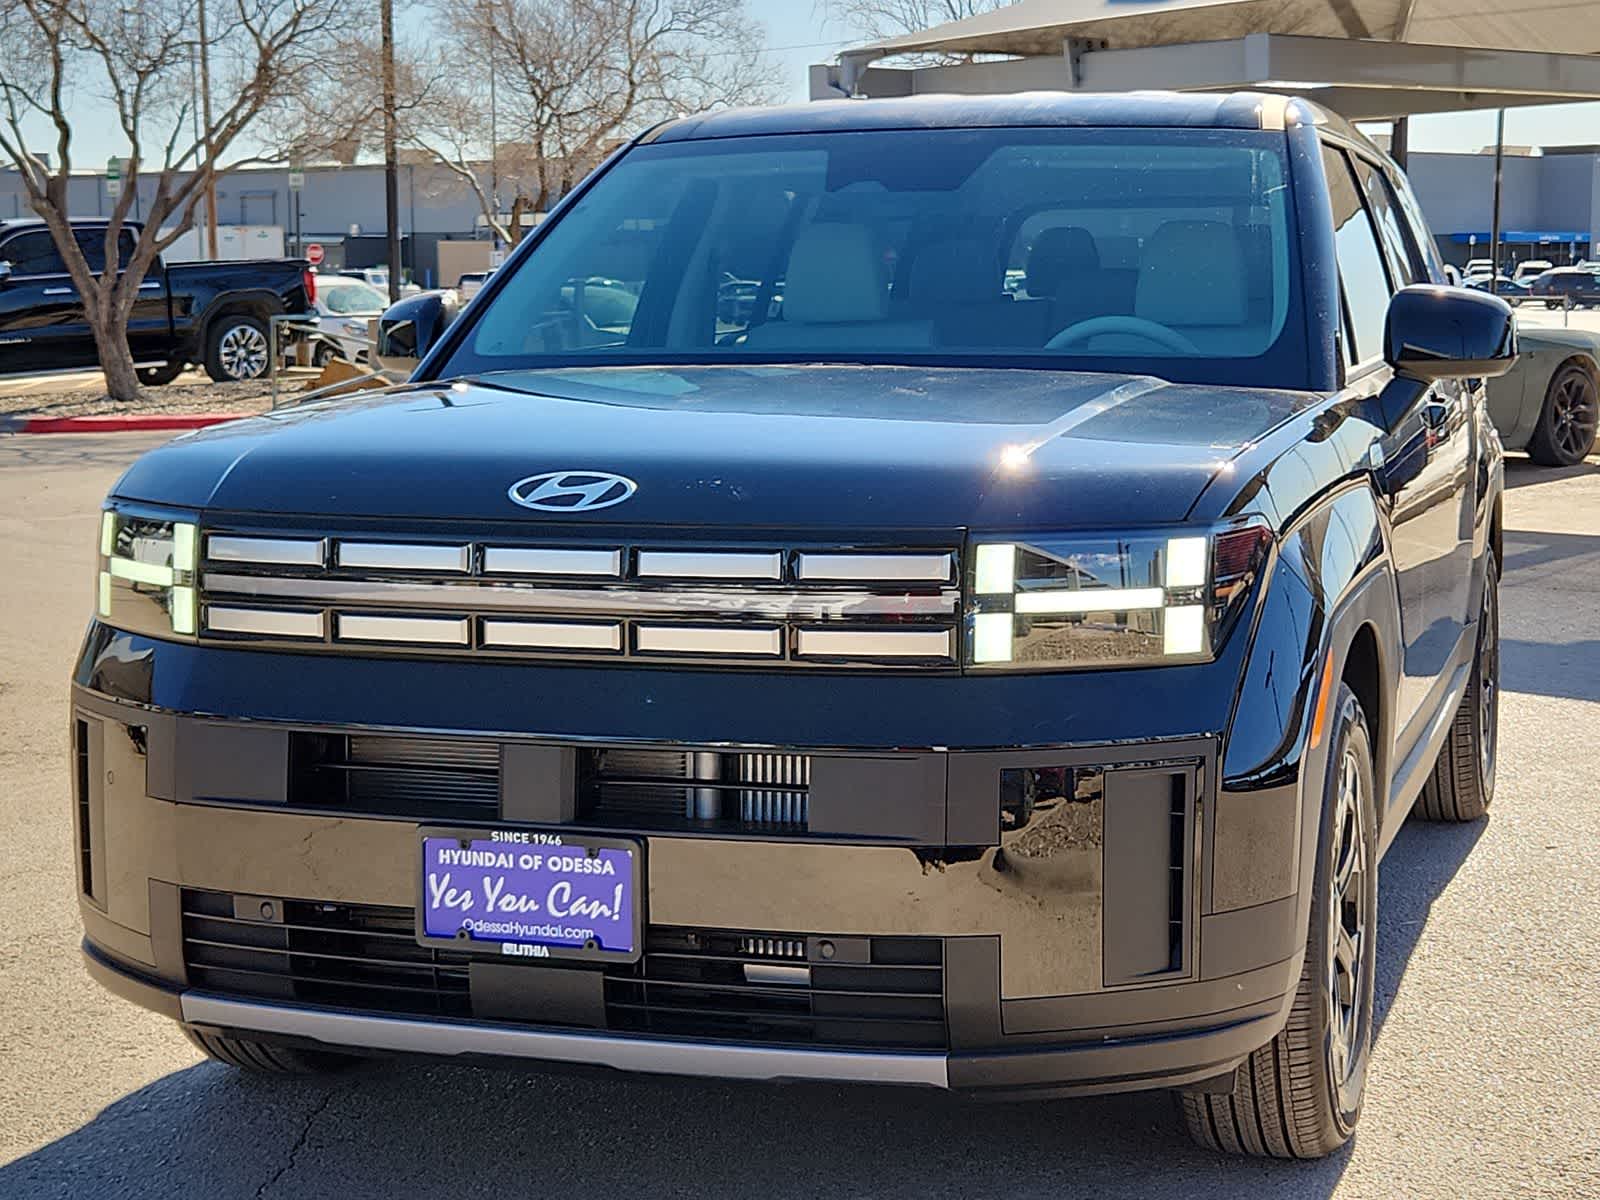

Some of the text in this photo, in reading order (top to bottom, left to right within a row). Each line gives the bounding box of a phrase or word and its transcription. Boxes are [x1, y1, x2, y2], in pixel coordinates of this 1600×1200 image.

[491, 831, 562, 846] SINCE 1946
[438, 849, 615, 875] HYUNDAI OF ODESSA
[428, 872, 624, 920] Yes You Can!
[462, 918, 594, 939] OdessaHyundai.com
[513, 943, 550, 958] LITHIA
